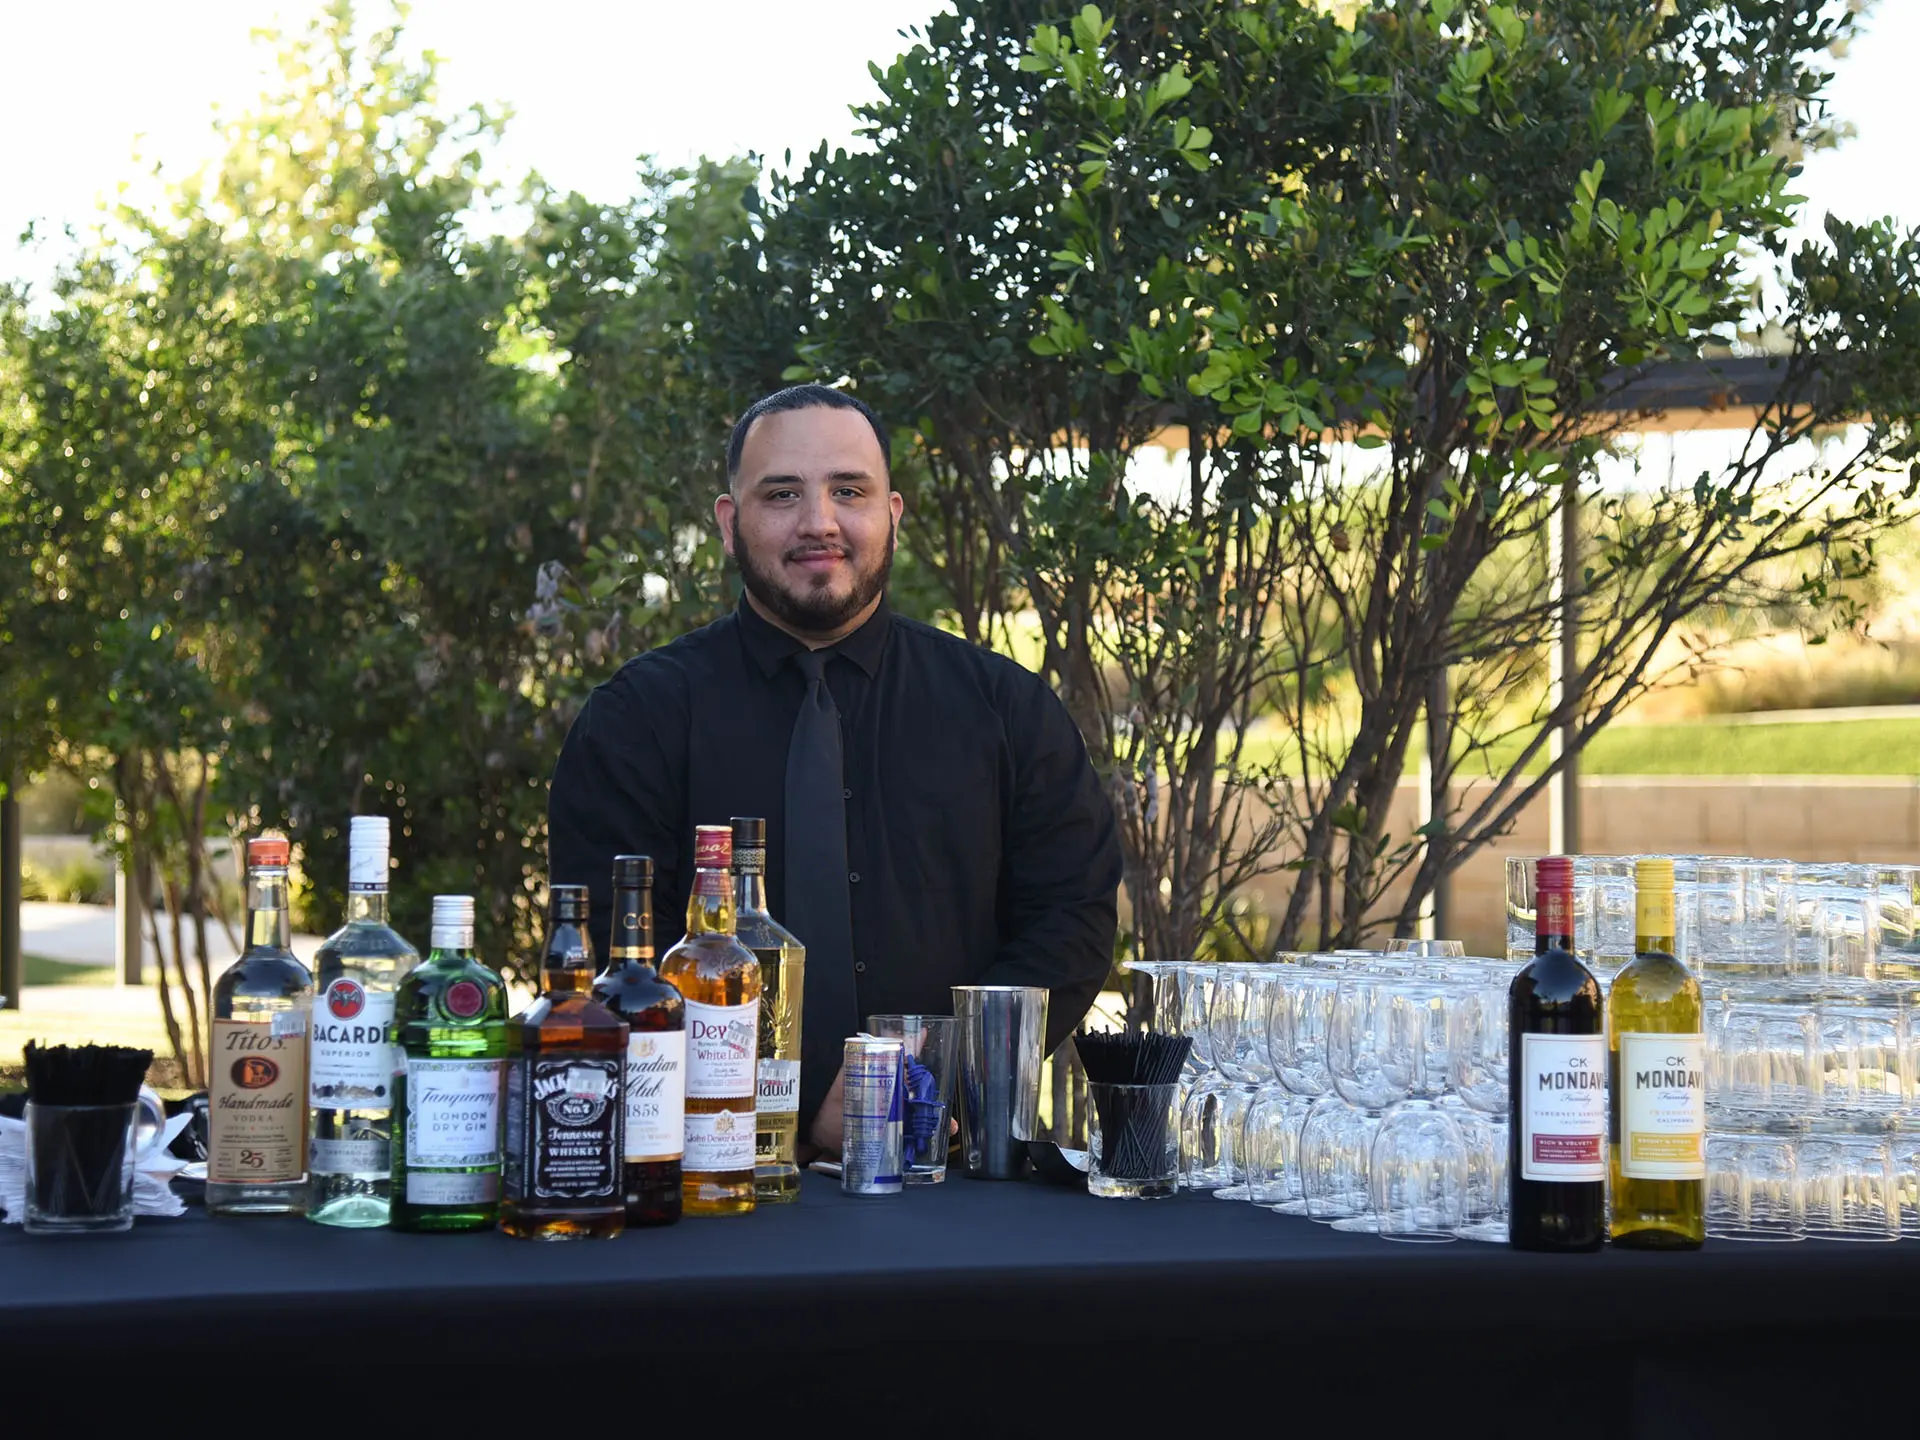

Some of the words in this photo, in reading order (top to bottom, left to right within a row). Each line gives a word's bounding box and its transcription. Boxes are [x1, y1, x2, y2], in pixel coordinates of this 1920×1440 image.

[697, 1050, 727, 1060] White
[626, 1054, 678, 1072] nadian
[1569, 1057, 1588, 1067] CK
[1666, 1056, 1686, 1066] CK
[218, 1093, 293, 1110] Handmade
[626, 1103, 660, 1118] 1858
[233, 1114, 274, 1122] VODKA
[433, 1111, 487, 1121] LONDON
[432, 1123, 459, 1132] DRY
[464, 1122, 487, 1132] GIN
[548, 1127, 604, 1141] Tennessee
[548, 1146, 602, 1157] WHISKEY
[240, 1149, 265, 1169] 25
